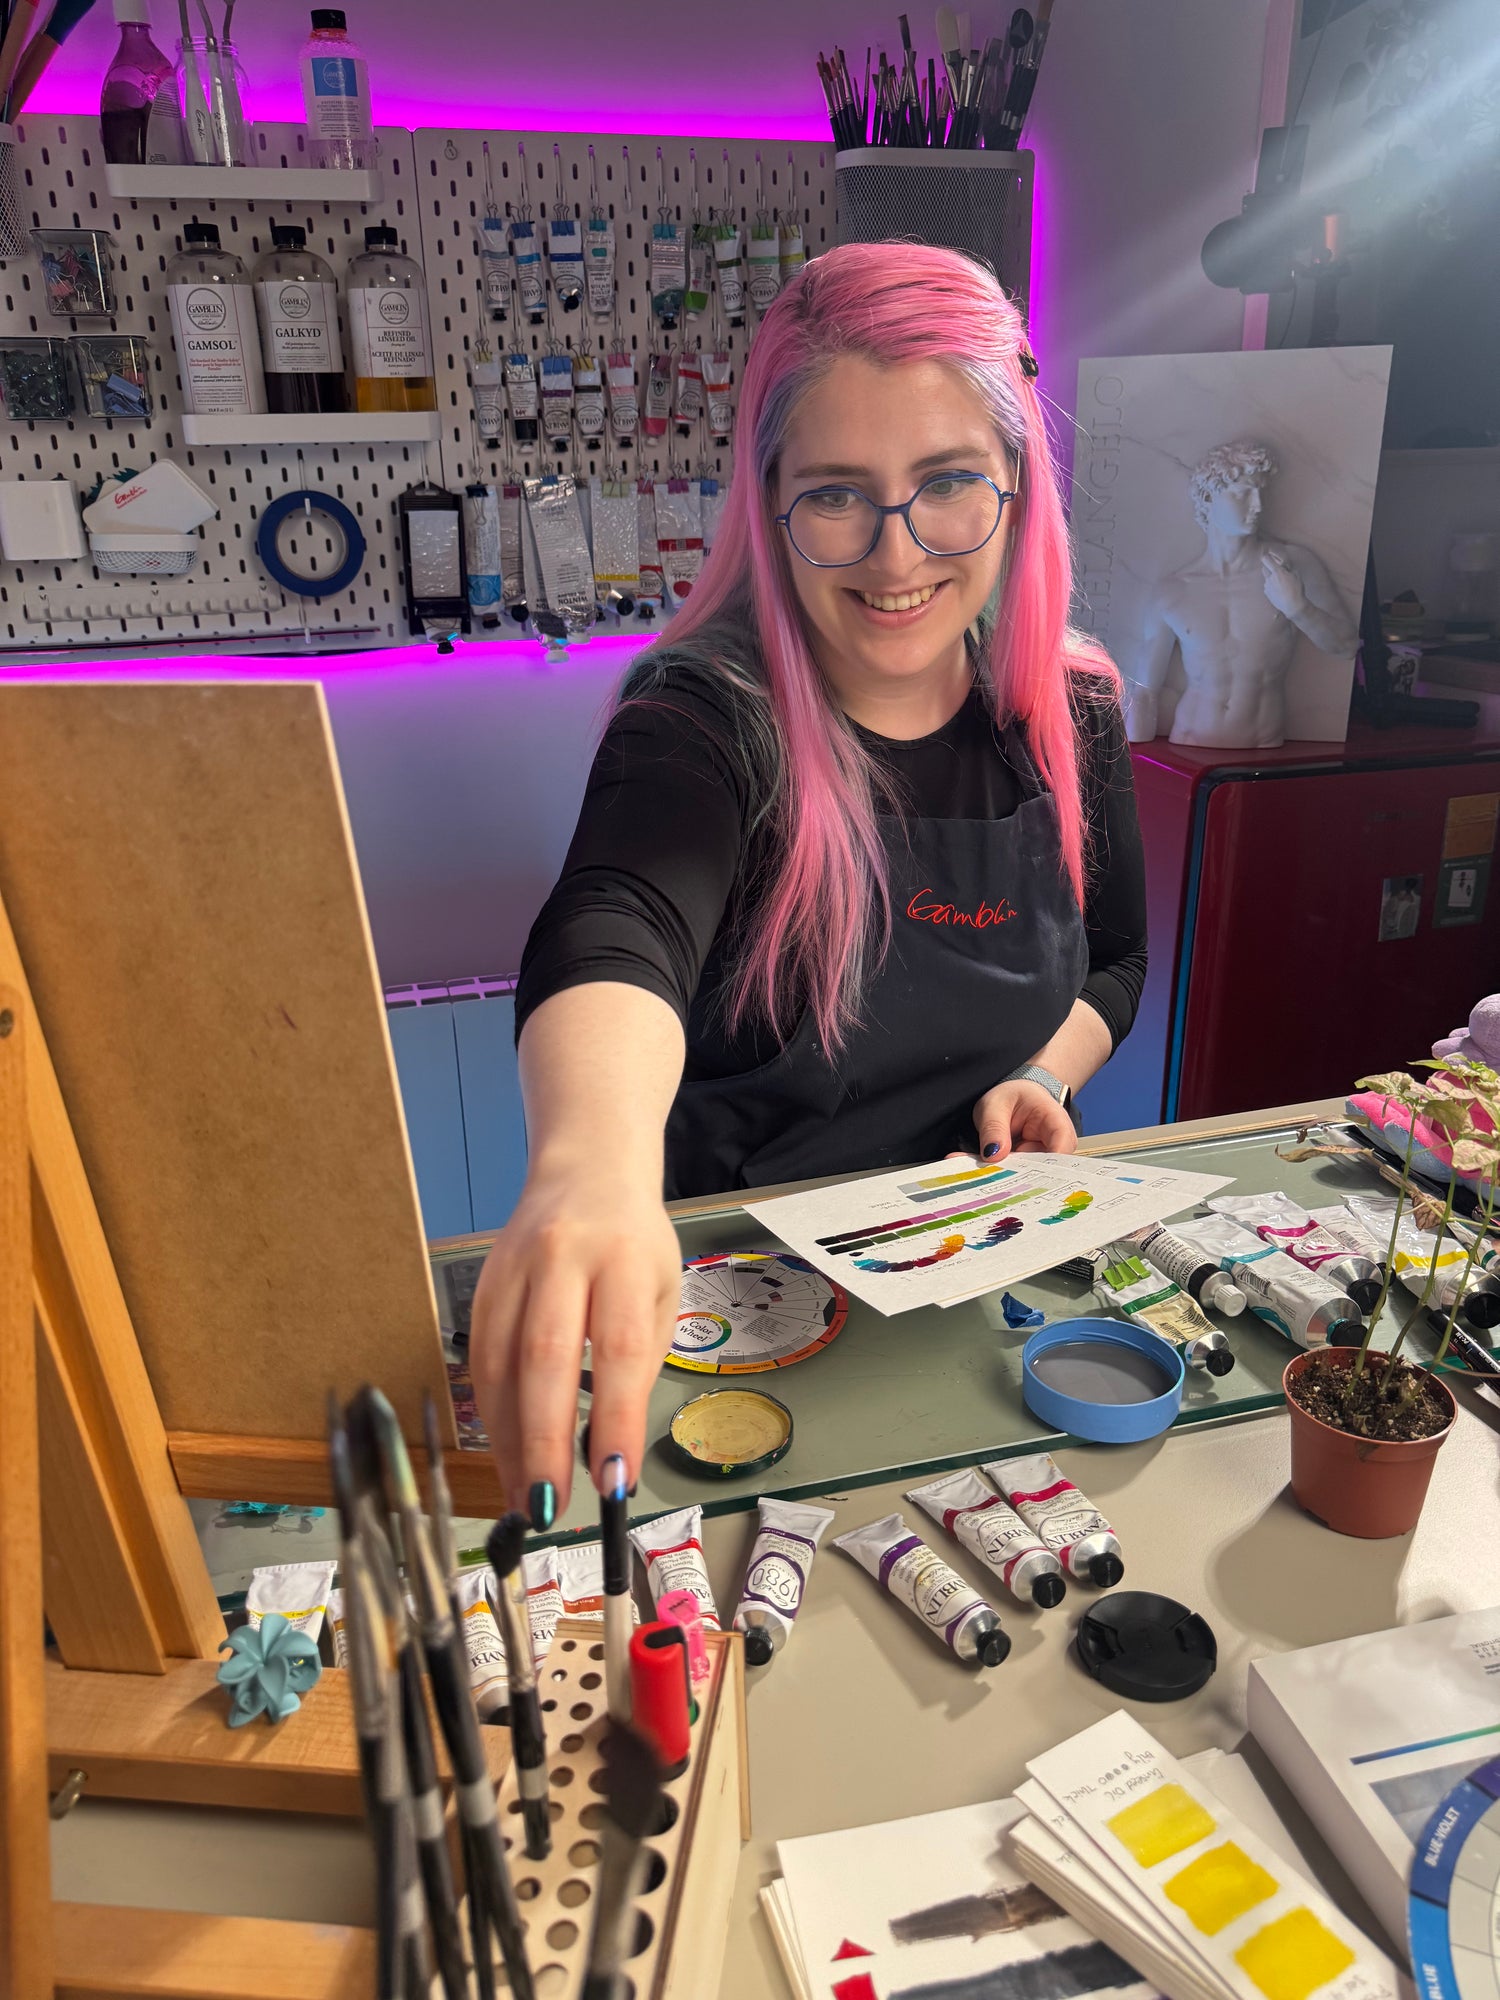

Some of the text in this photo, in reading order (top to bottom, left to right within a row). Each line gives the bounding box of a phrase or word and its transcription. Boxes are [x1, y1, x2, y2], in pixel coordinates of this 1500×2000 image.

[188, 305, 223, 314] GAMBLIN
[275, 328, 321, 337] GALKYD
[188, 340, 236, 351] GAMSOL
[1083, 375, 1124, 632] HELANGELO
[558, 596, 588, 605] WINTON
[906, 888, 1018, 928] Gamblin
[679, 1326, 707, 1342] Wheel
[689, 1320, 714, 1335] Color
[752, 1568, 798, 1602] 1980
[1424, 1806, 1460, 1867] BLUE-VIOLET
